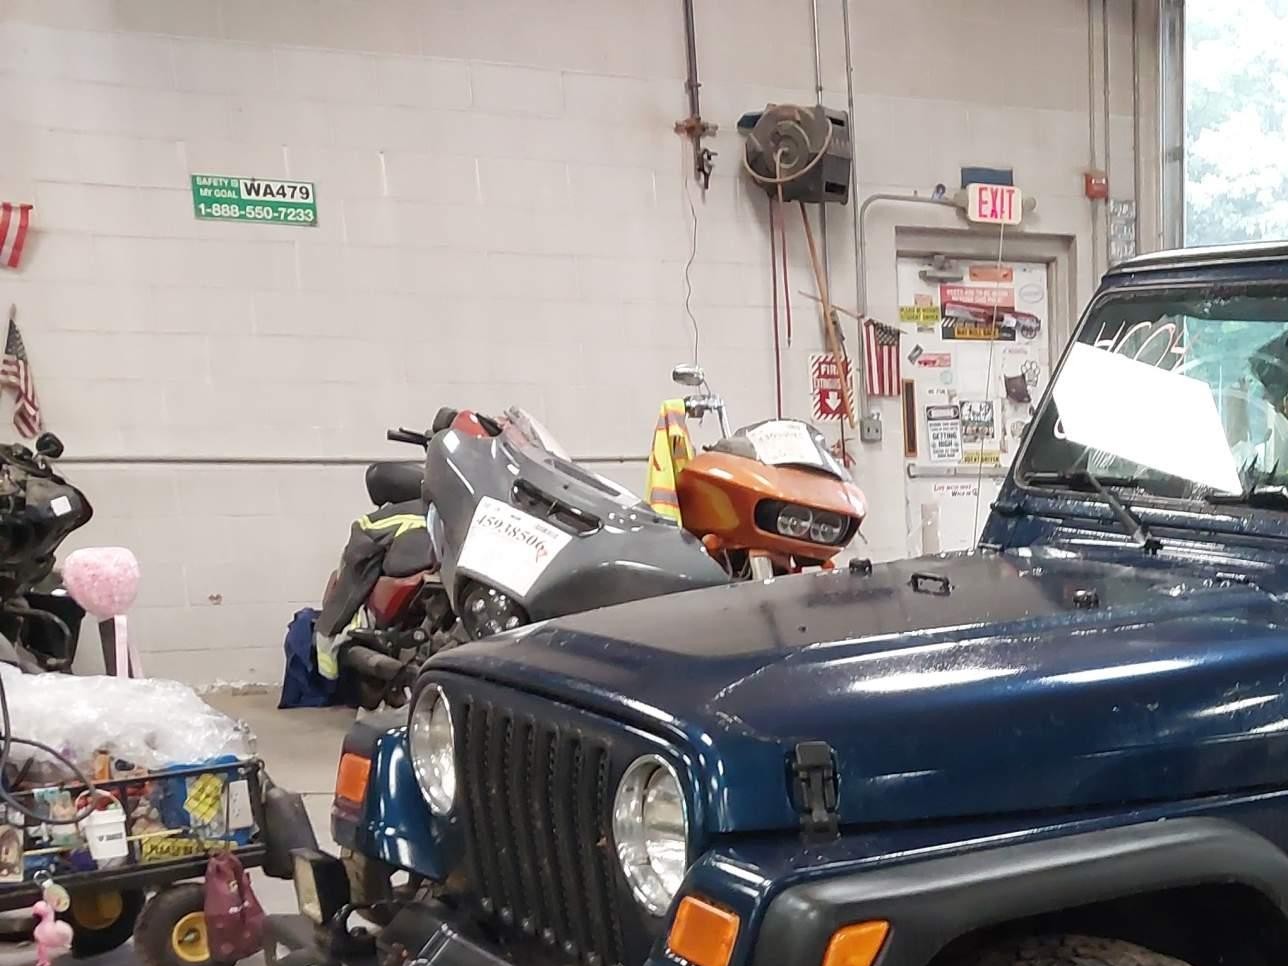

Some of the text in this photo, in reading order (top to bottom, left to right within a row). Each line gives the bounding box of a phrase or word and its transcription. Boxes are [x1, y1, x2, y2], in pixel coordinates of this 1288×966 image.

[196, 176, 229, 187] SAFETY
[244, 182, 310, 200] WA479
[199, 188, 239, 198] MY GOAL
[198, 202, 314, 221] 1-888-550-7233
[978, 186, 1016, 220] EXIT
